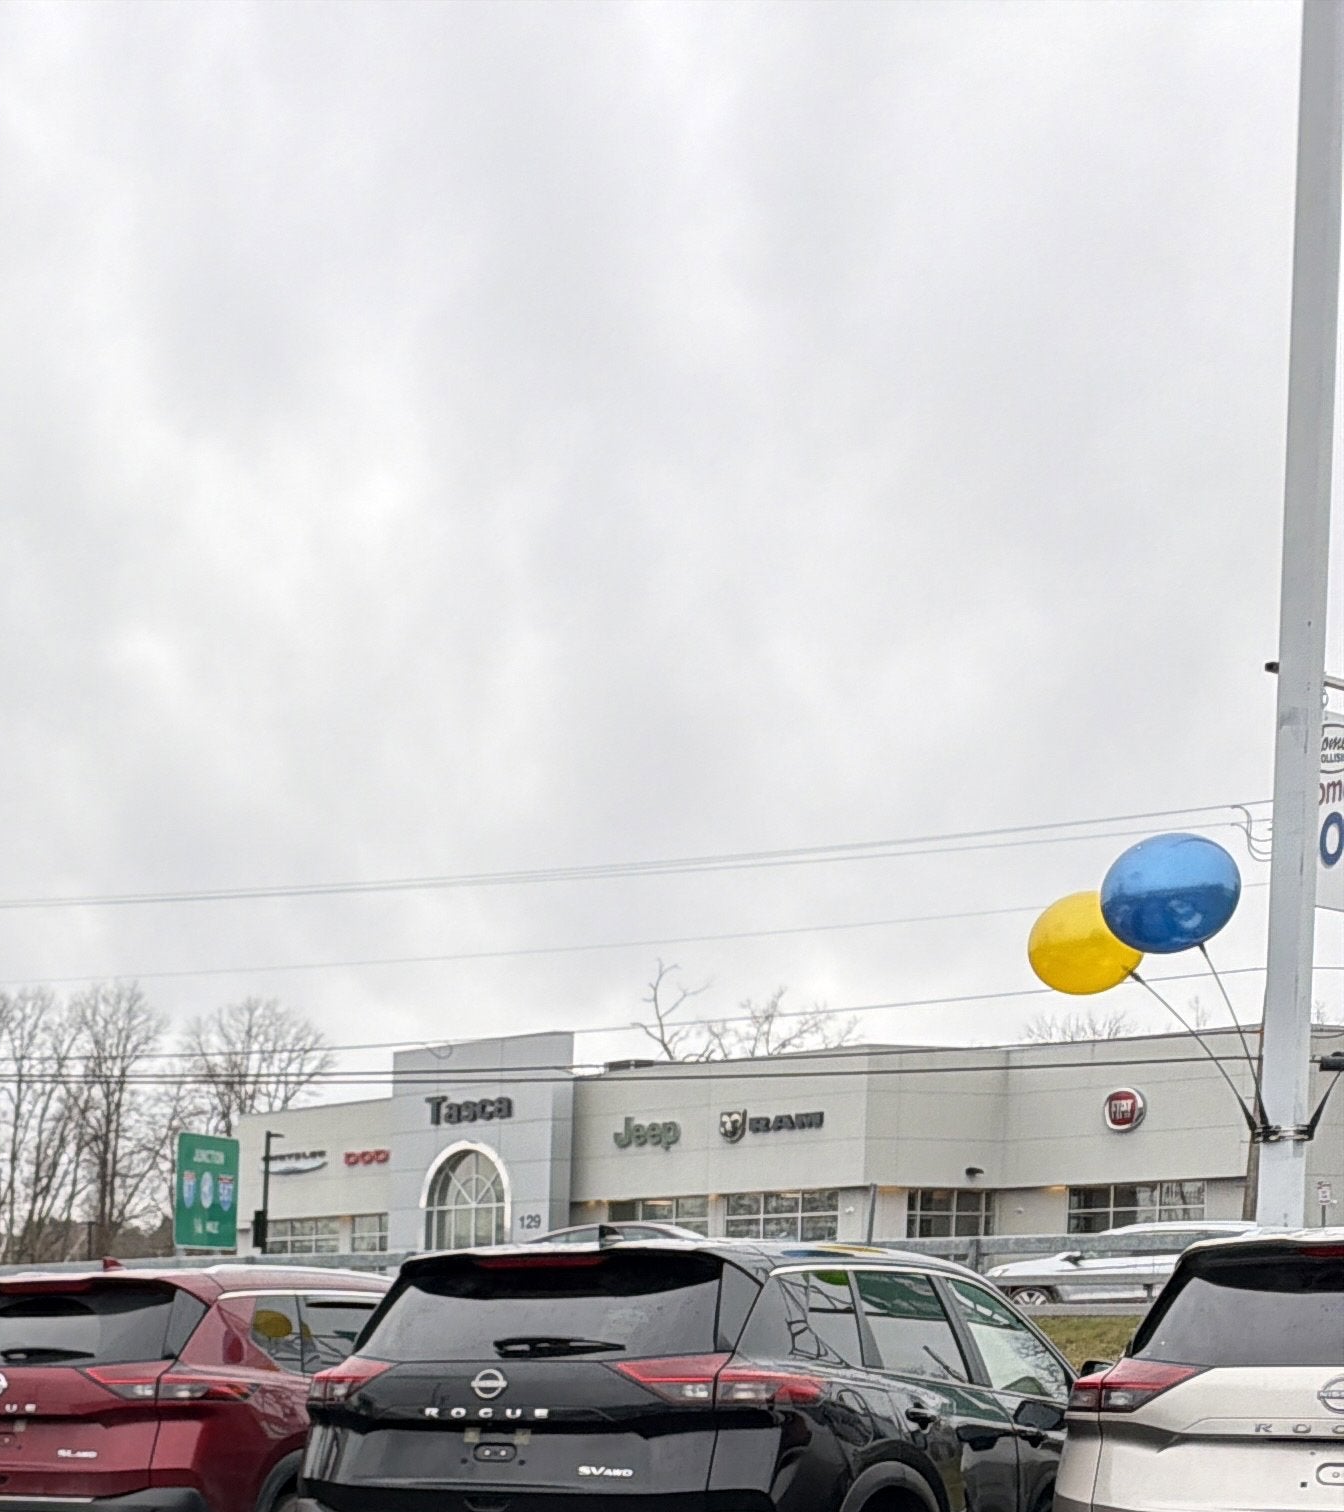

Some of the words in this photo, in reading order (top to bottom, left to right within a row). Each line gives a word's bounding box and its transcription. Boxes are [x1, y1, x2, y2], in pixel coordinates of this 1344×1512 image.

[424, 1096, 513, 1126] Tasca
[613, 1116, 682, 1150] Jeep
[748, 1112, 824, 1134] RAM
[518, 1214, 542, 1229] 129
[424, 1407, 549, 1418] ROGUE
